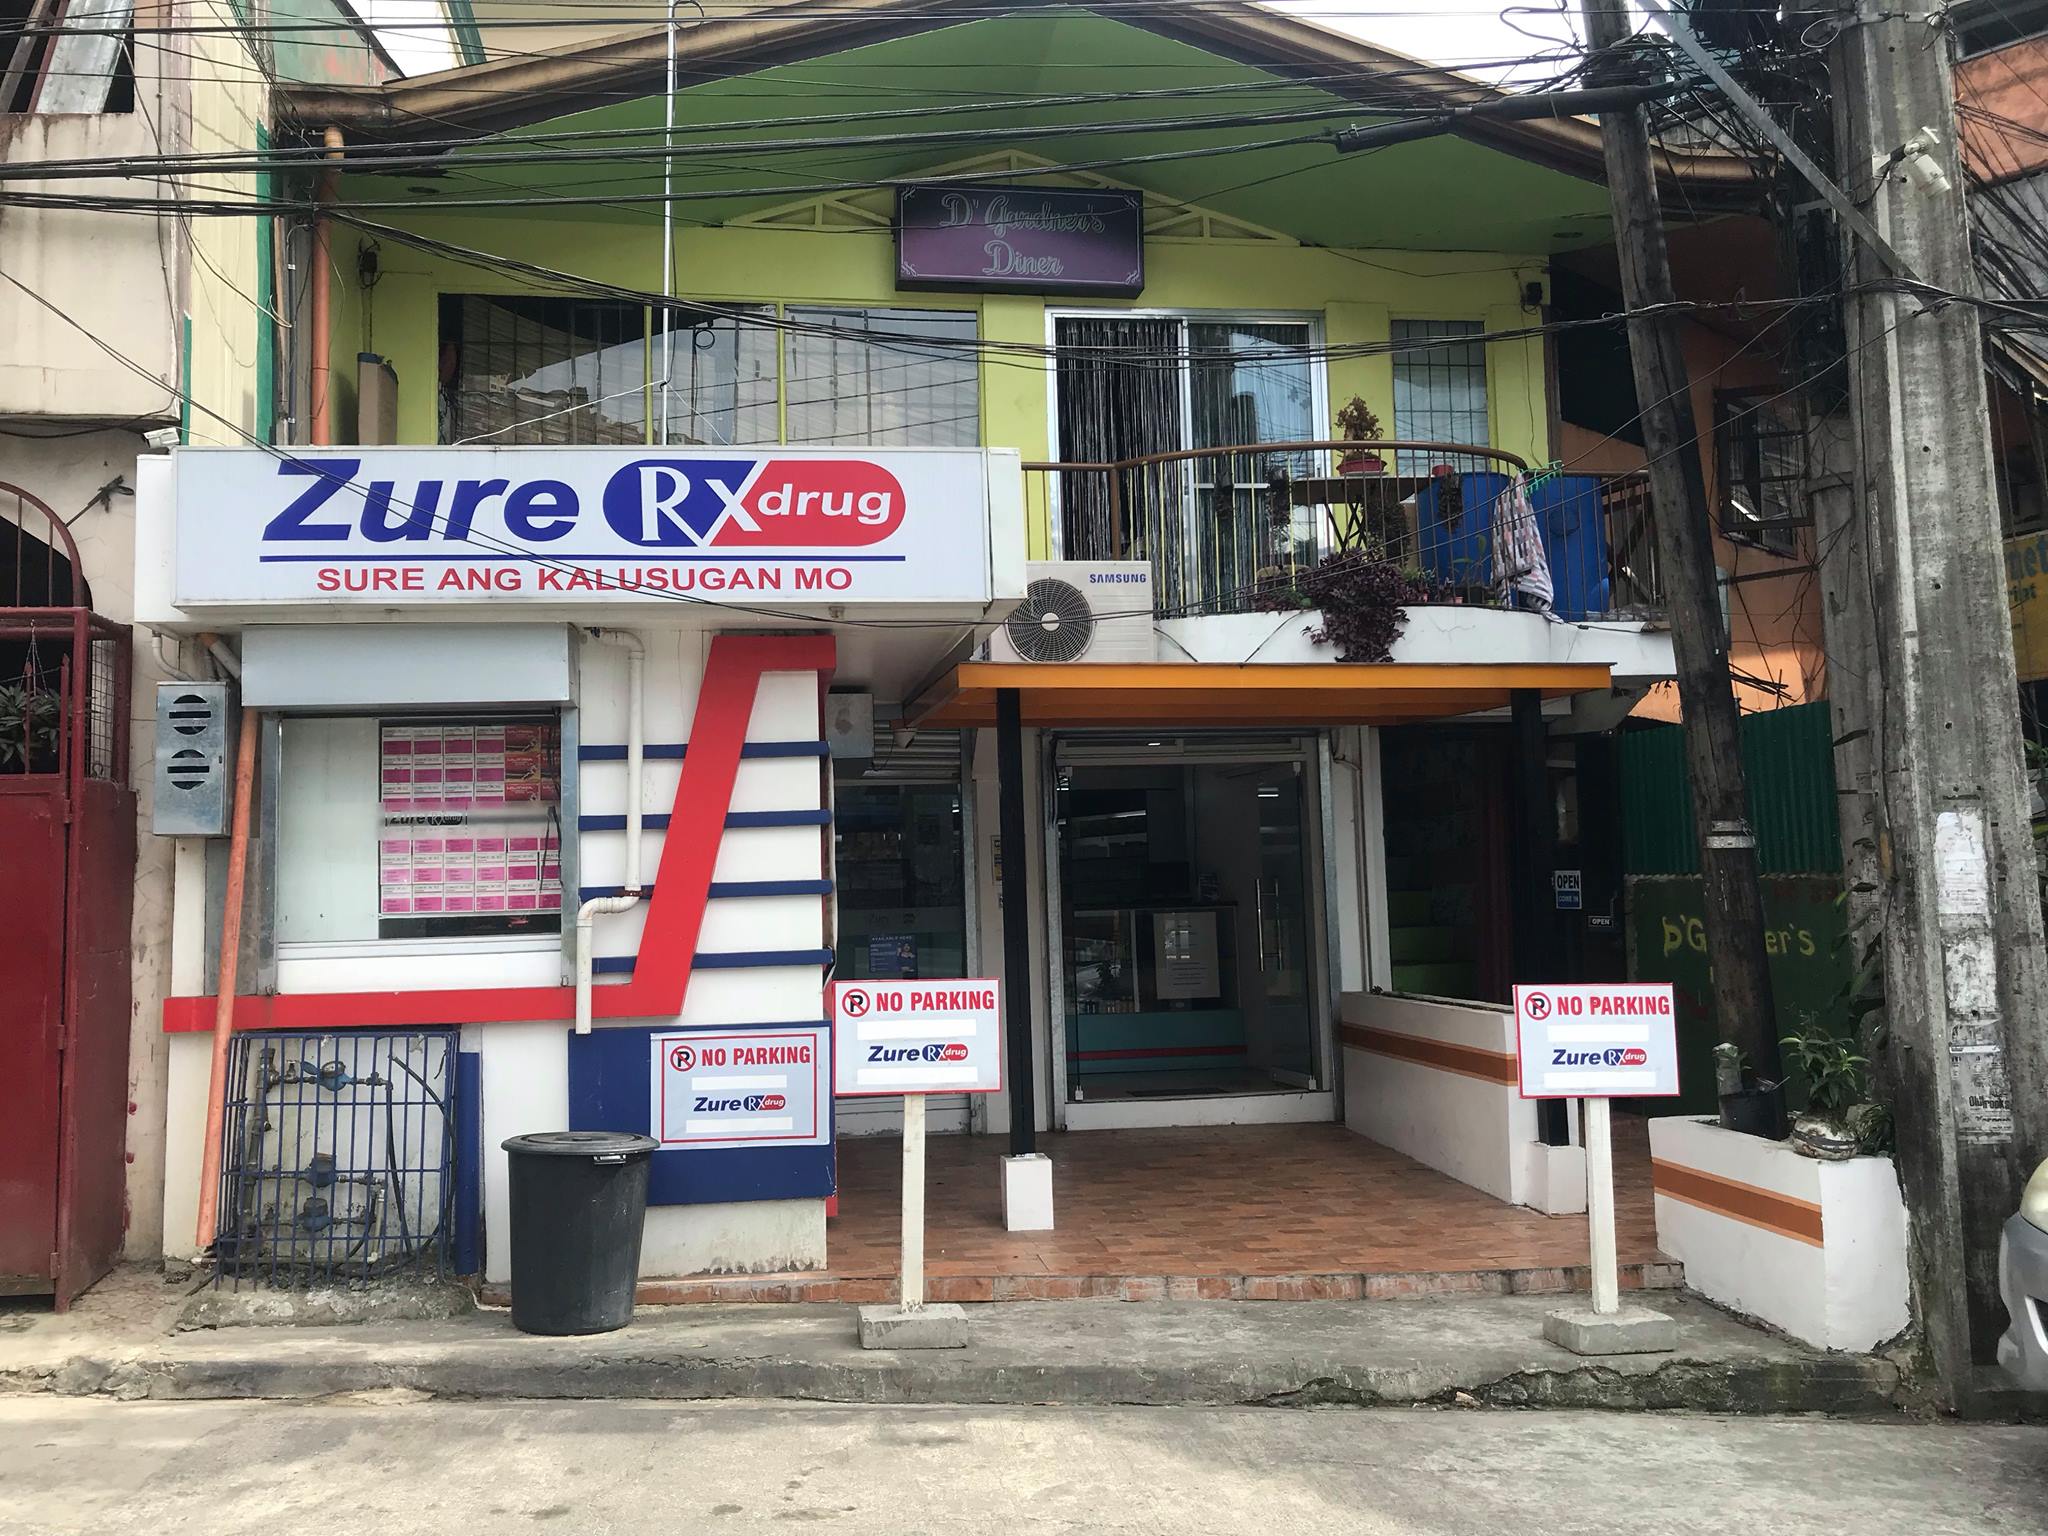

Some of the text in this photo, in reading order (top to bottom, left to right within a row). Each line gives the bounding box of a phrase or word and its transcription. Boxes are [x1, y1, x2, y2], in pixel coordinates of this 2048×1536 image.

[982, 239, 1064, 275] Diner
[262, 459, 579, 542] Zure
[316, 567, 852, 591] SURE ANG KALUSUGAN MO
[1089, 573, 1147, 584] SAMSUNG
[1557, 874, 1580, 889] OPEN
[876, 990, 994, 1011] NO PARKING
[1557, 996, 1670, 1015] NO PARKING
[702, 1046, 811, 1066] NO PARKING
[867, 1045, 920, 1062] Zure
[1552, 1049, 1601, 1065] Zure
[693, 1096, 742, 1112] Zure
